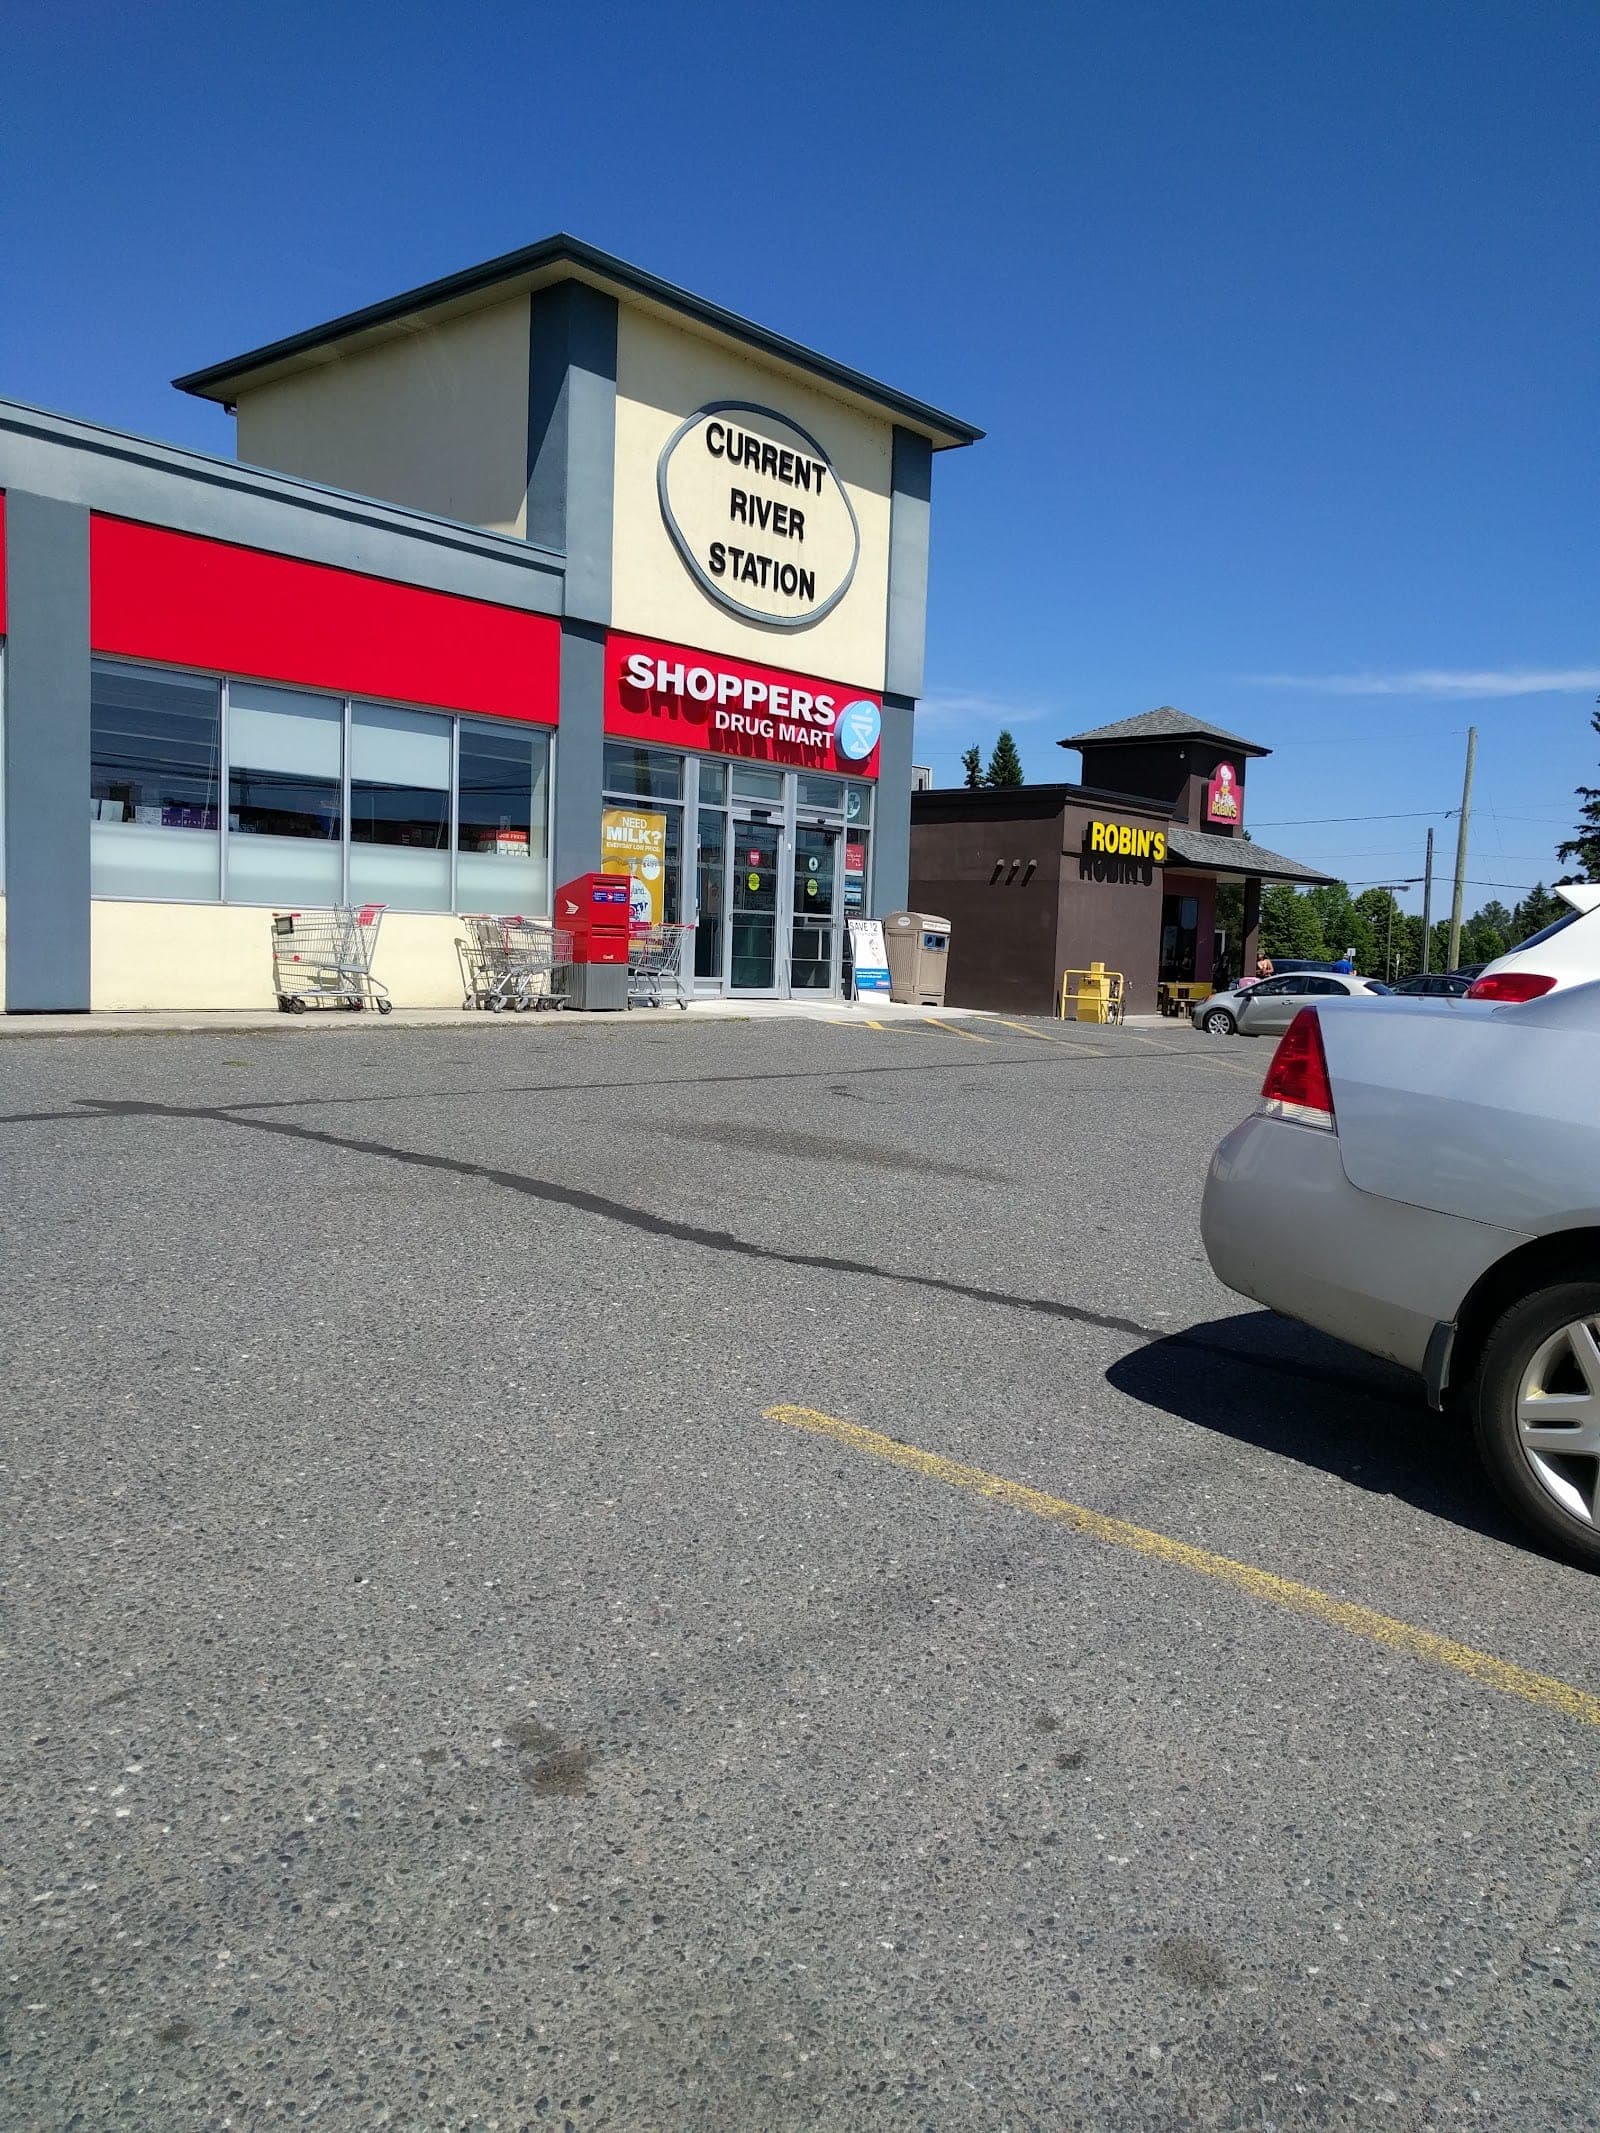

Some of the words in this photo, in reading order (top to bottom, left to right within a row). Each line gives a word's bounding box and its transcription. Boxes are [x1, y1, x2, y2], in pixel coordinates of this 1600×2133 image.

[706, 423, 827, 494] CURRENT
[731, 488, 805, 541] RIVER
[709, 542, 815, 600] STATION
[626, 654, 836, 726] SHOPPERS
[715, 711, 773, 738] DRUG
[779, 724, 834, 749] MART
[622, 816, 648, 829] NEED
[1211, 801, 1237, 818] ROBIN'S
[606, 826, 662, 846] MILK?
[1091, 821, 1166, 861] ROBIN'S
[849, 921, 869, 932] SAVE
